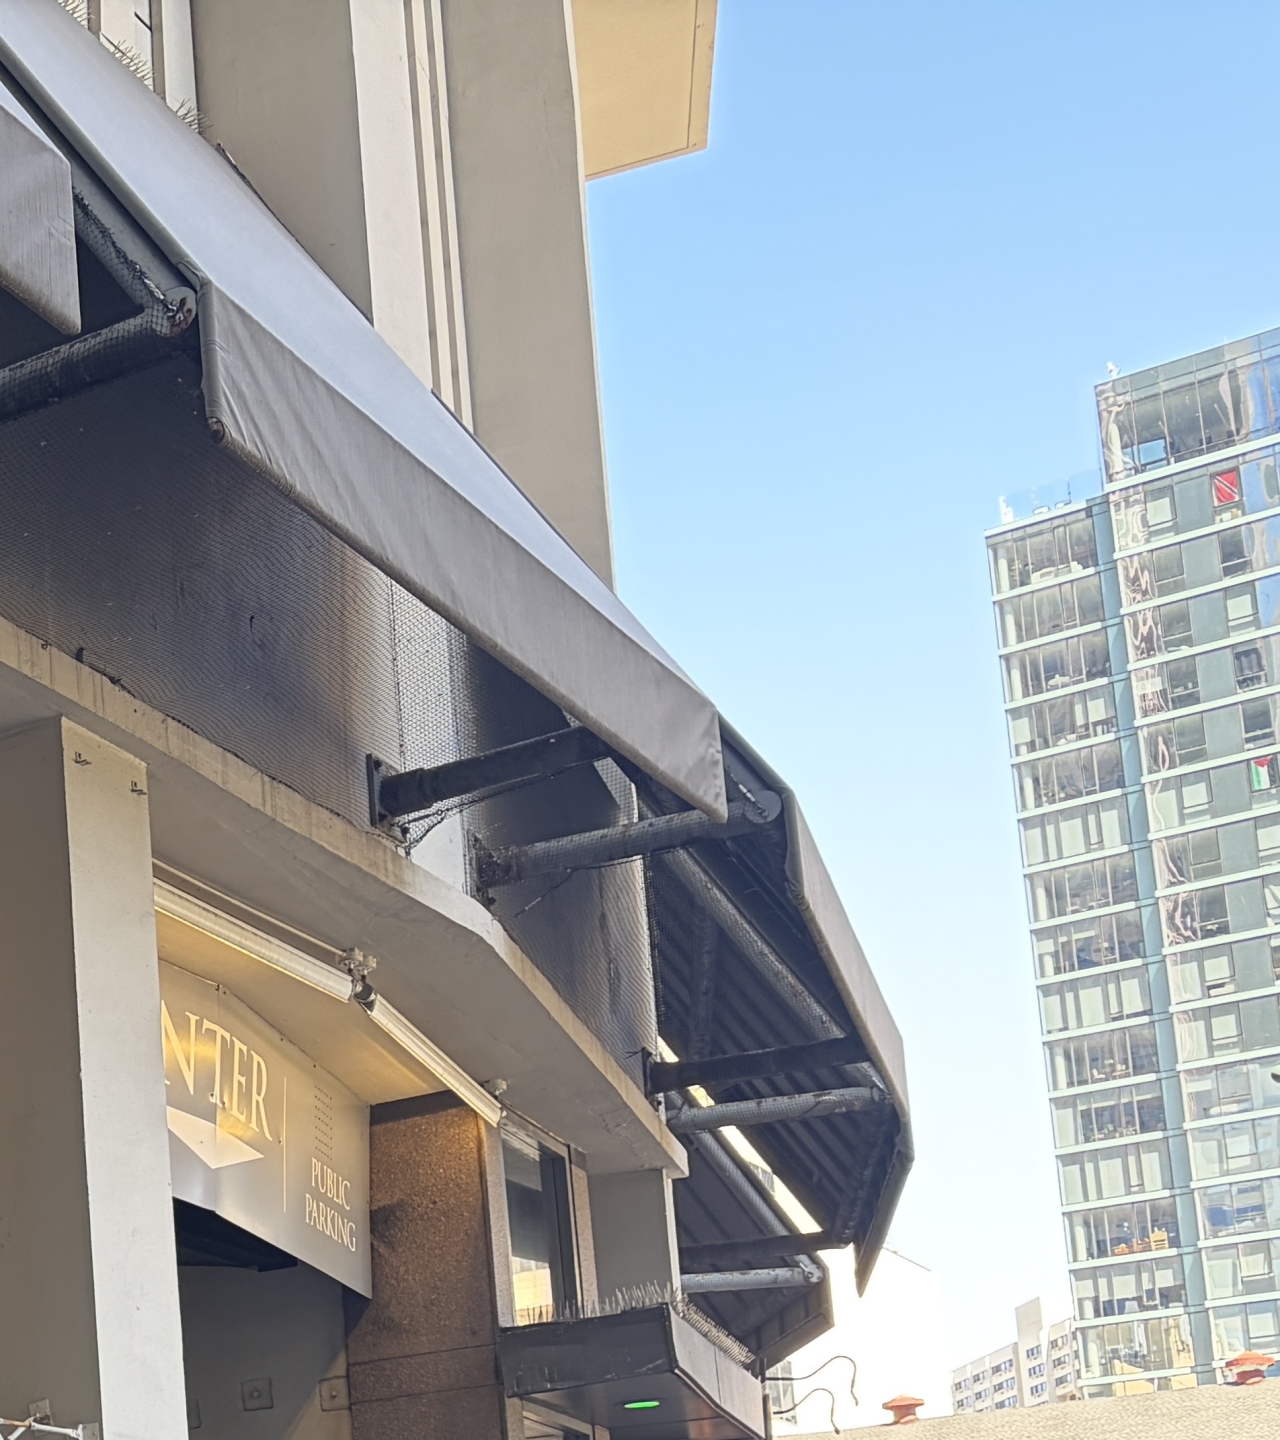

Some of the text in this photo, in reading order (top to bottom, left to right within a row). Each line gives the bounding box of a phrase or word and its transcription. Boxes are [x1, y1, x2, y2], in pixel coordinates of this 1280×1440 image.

[161, 1000, 273, 1141] NTER
[311, 1157, 350, 1211] PUBLIC
[305, 1193, 356, 1252] PARKING
